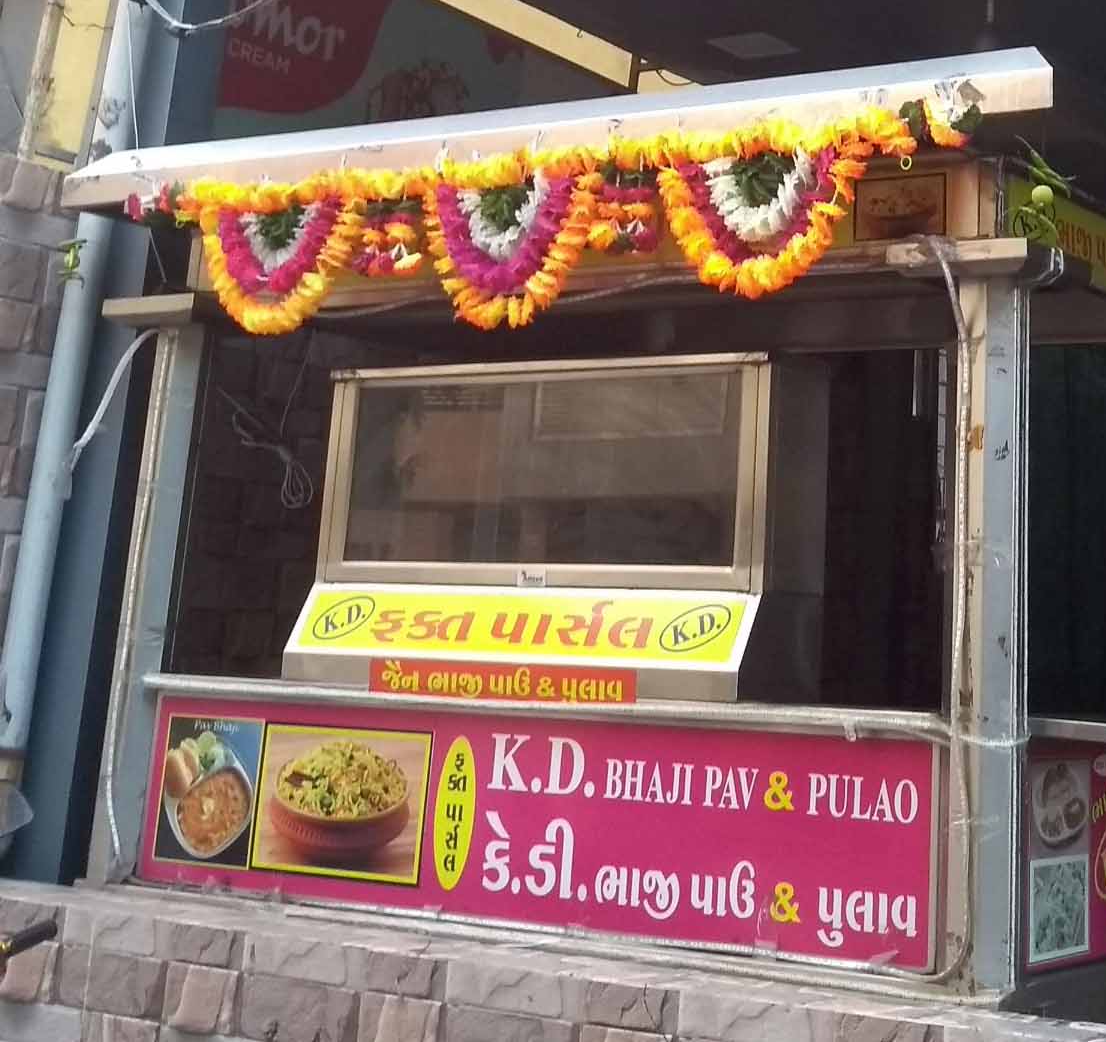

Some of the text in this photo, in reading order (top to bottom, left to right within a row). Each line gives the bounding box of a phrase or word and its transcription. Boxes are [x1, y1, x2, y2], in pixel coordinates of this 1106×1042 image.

[323, 603, 366, 635] K.D.
[370, 600, 654, 649] ફક્ત પાર્સલ
[671, 611, 722, 647] K.D.
[427, 669, 483, 699] ભાજી
[489, 666, 531, 696] પાઉ
[536, 675, 556, 698] &
[487, 732, 920, 825] K.D. BHAJI PAV & PULAO
[594, 864, 681, 921] ભાજી
[690, 859, 756, 920] પાઉ
[769, 881, 802, 924] &
[816, 886, 918, 948] પુલાવ
